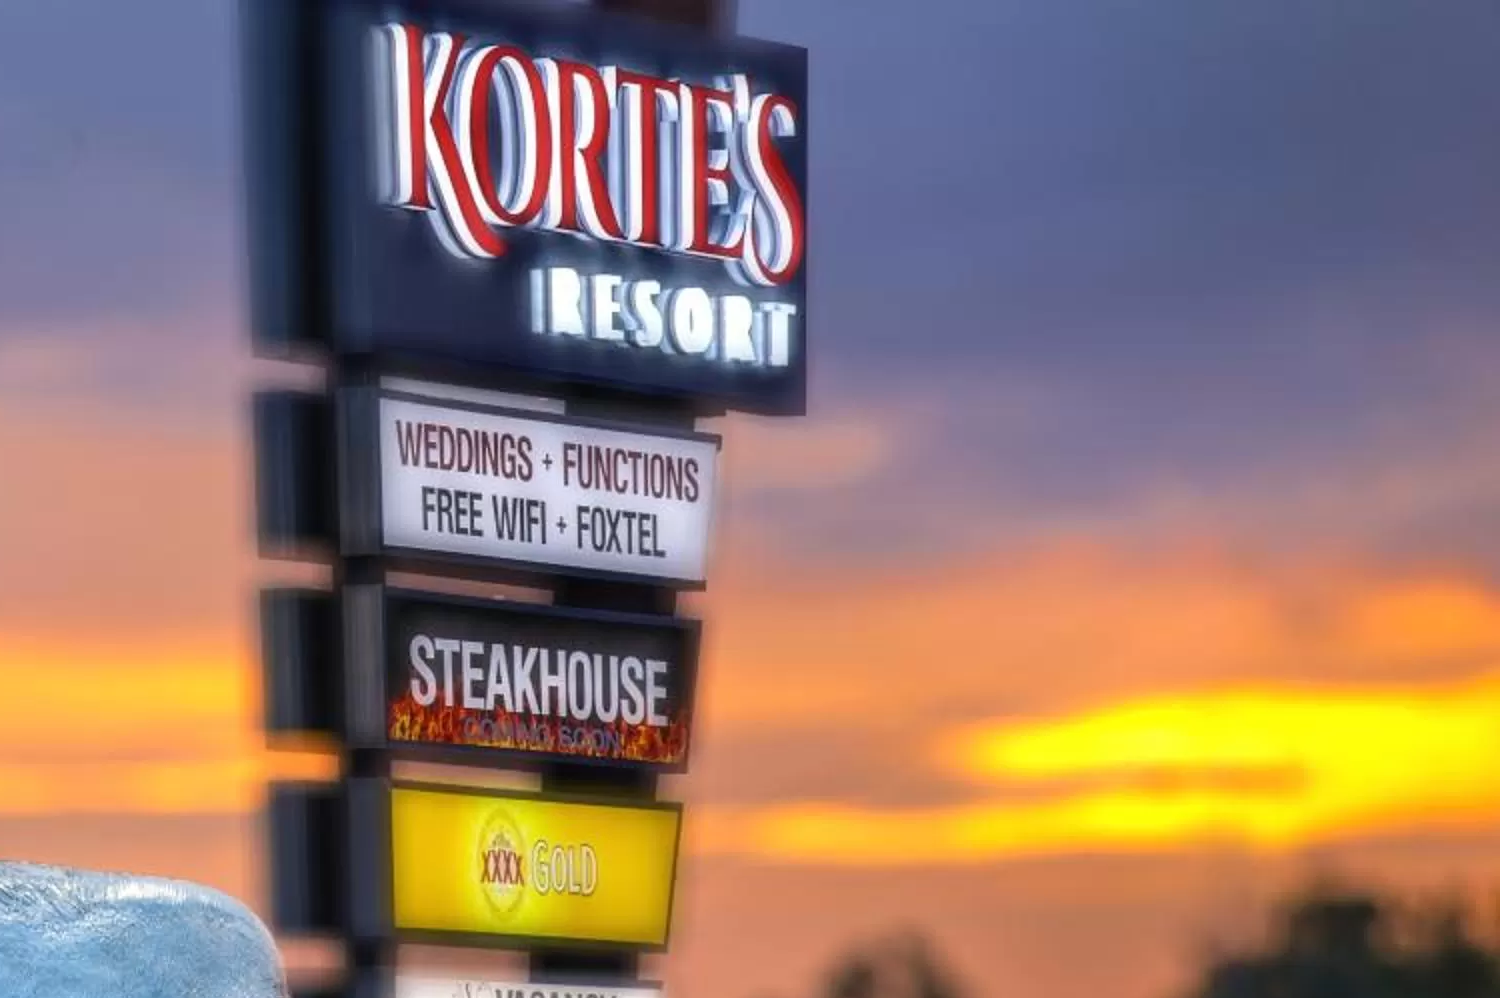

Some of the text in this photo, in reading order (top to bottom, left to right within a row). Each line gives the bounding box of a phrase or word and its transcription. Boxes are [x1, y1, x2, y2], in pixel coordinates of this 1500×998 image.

[532, 267, 797, 367] RESORT
[396, 419, 533, 482] WEDDINGS
[563, 441, 699, 502] FUNCTIONS
[421, 486, 483, 537] FREE
[493, 495, 547, 544] WIFI
[577, 506, 666, 557] FOXTEL
[409, 634, 668, 727] STEAKHOUSE
[480, 849, 525, 886] XXXX
